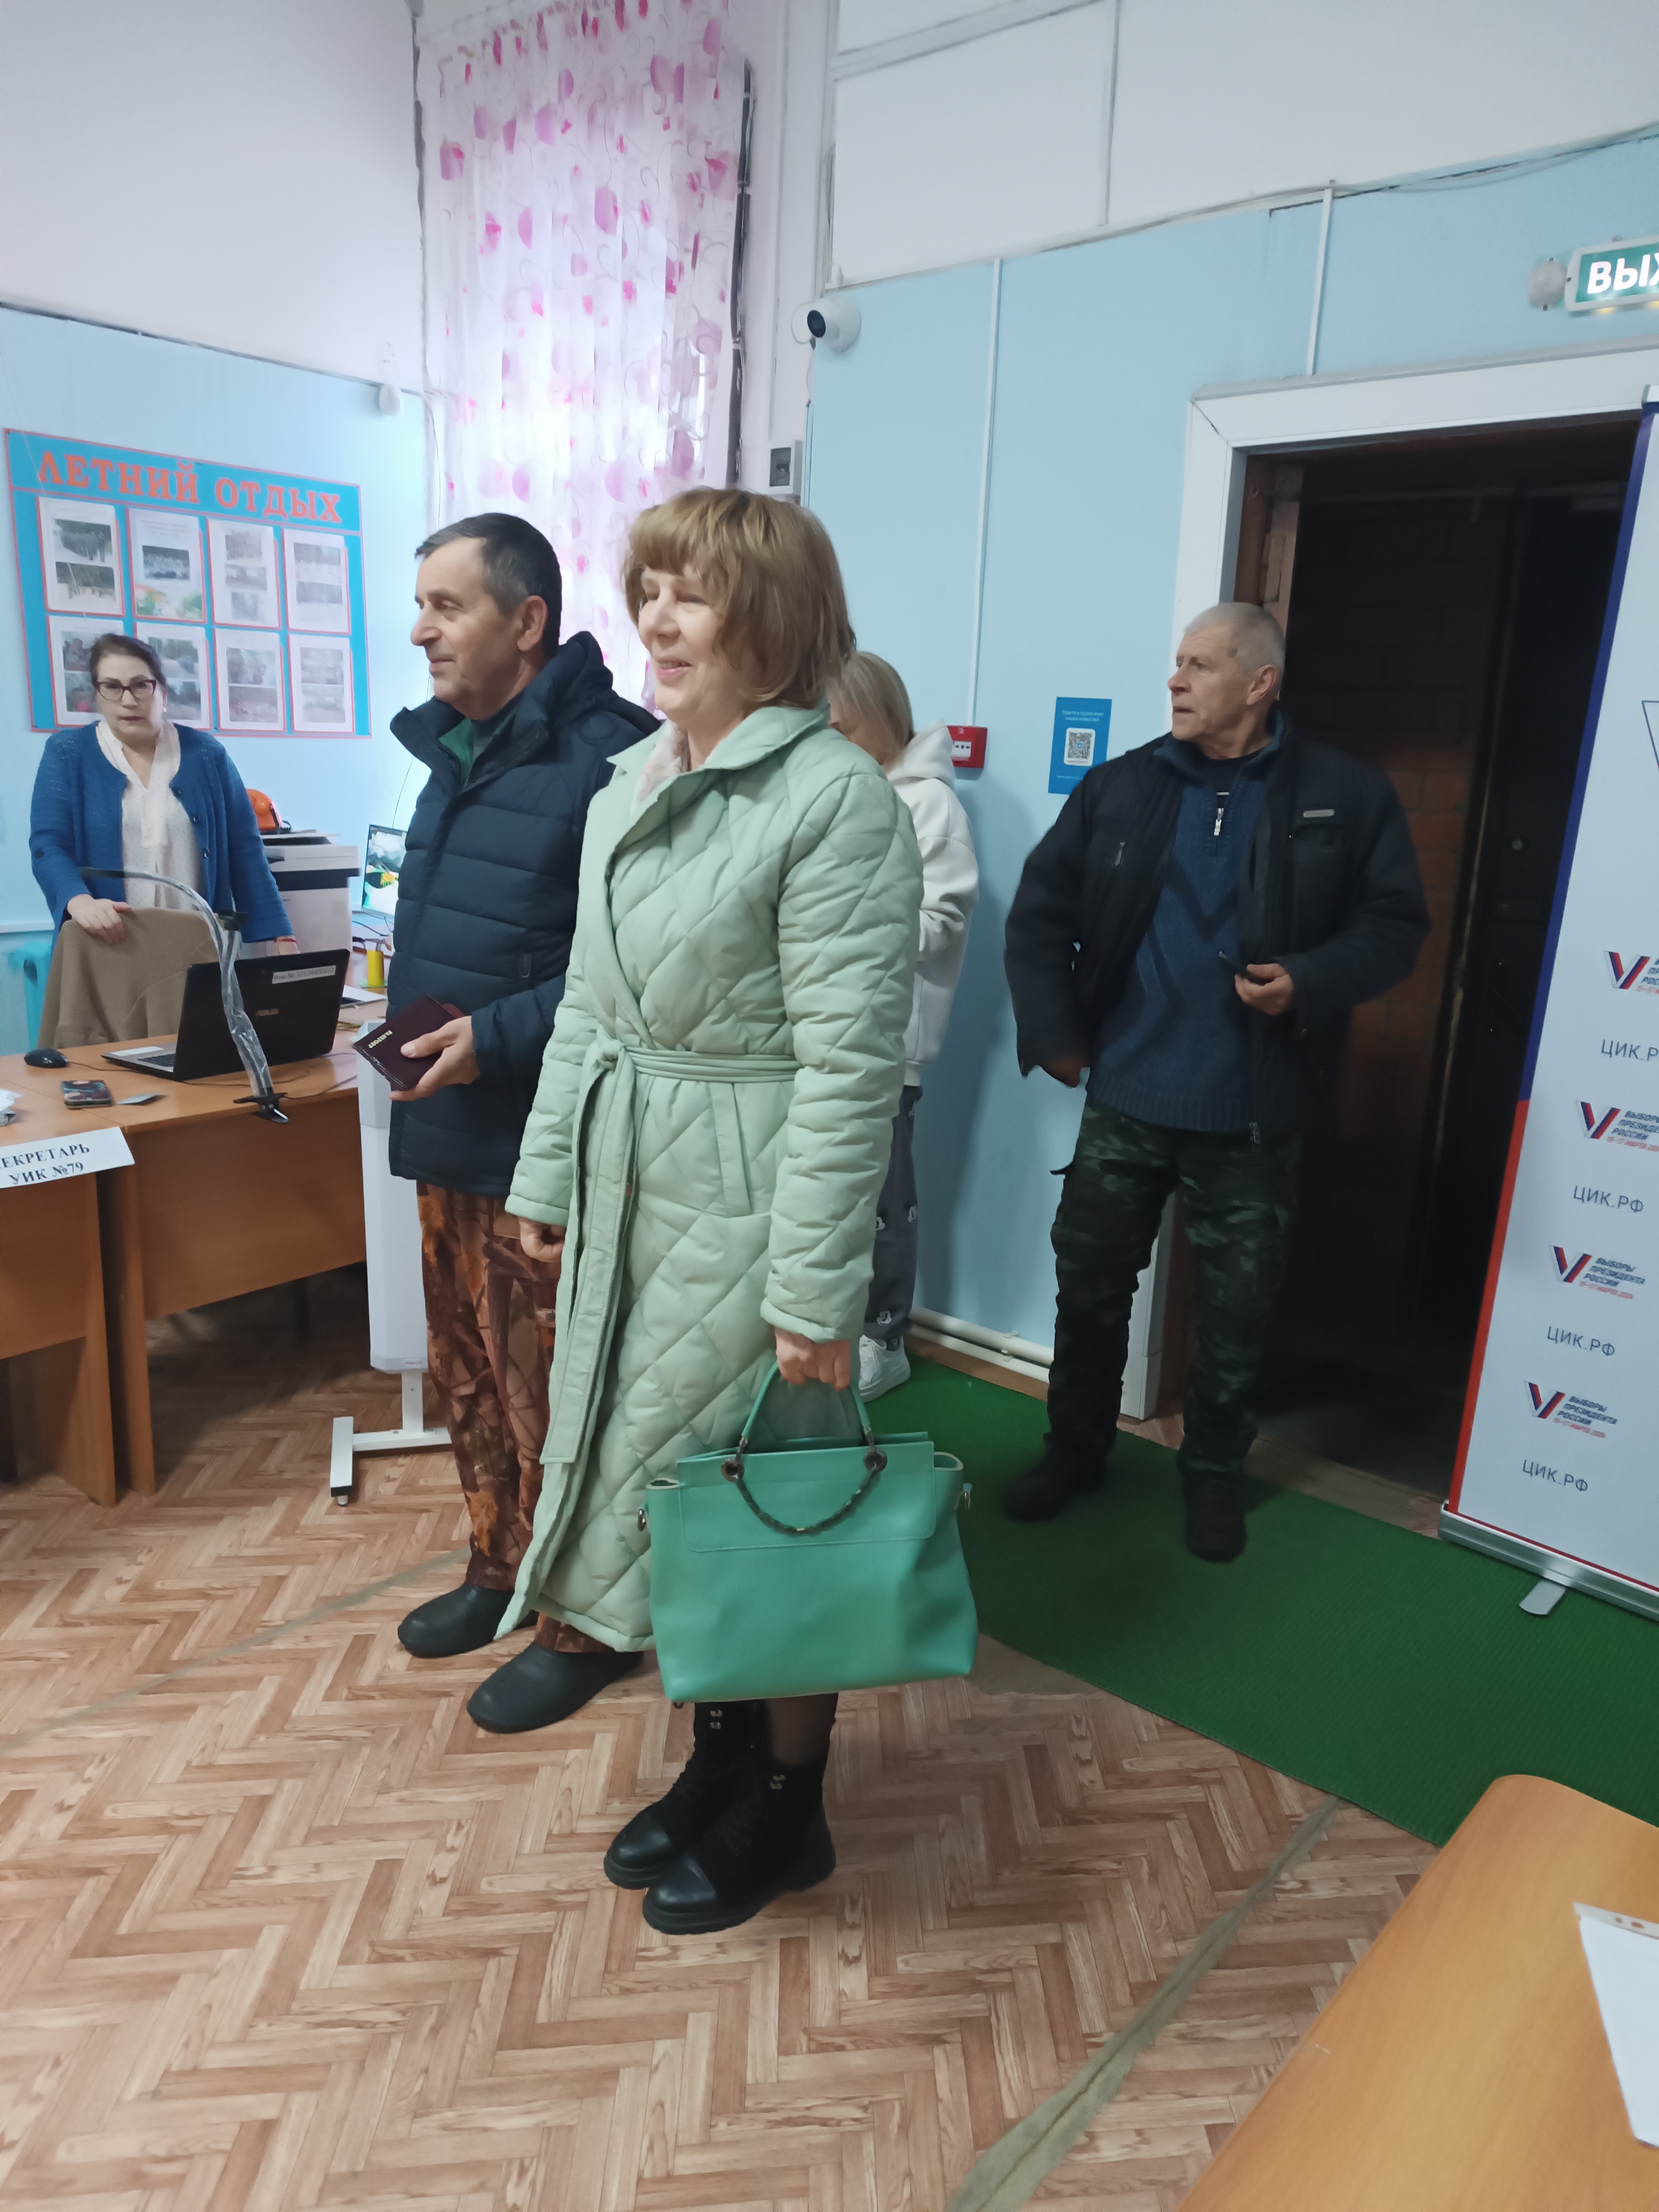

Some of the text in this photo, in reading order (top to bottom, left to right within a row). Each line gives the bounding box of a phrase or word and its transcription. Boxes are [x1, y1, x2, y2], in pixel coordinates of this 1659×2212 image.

[39, 450, 342, 523] ЛЕТНИЙ ОТДЫХ
[0, 1144, 90, 1168] ЕКРЕТАРЬ
[8, 1162, 84, 1185] УИК №79
[1573, 1185, 1644, 1213] ЦИК.РФ
[1547, 1326, 1615, 1356] ЦИК.РФ
[1522, 1459, 1588, 1492] ЦИК.РФ
